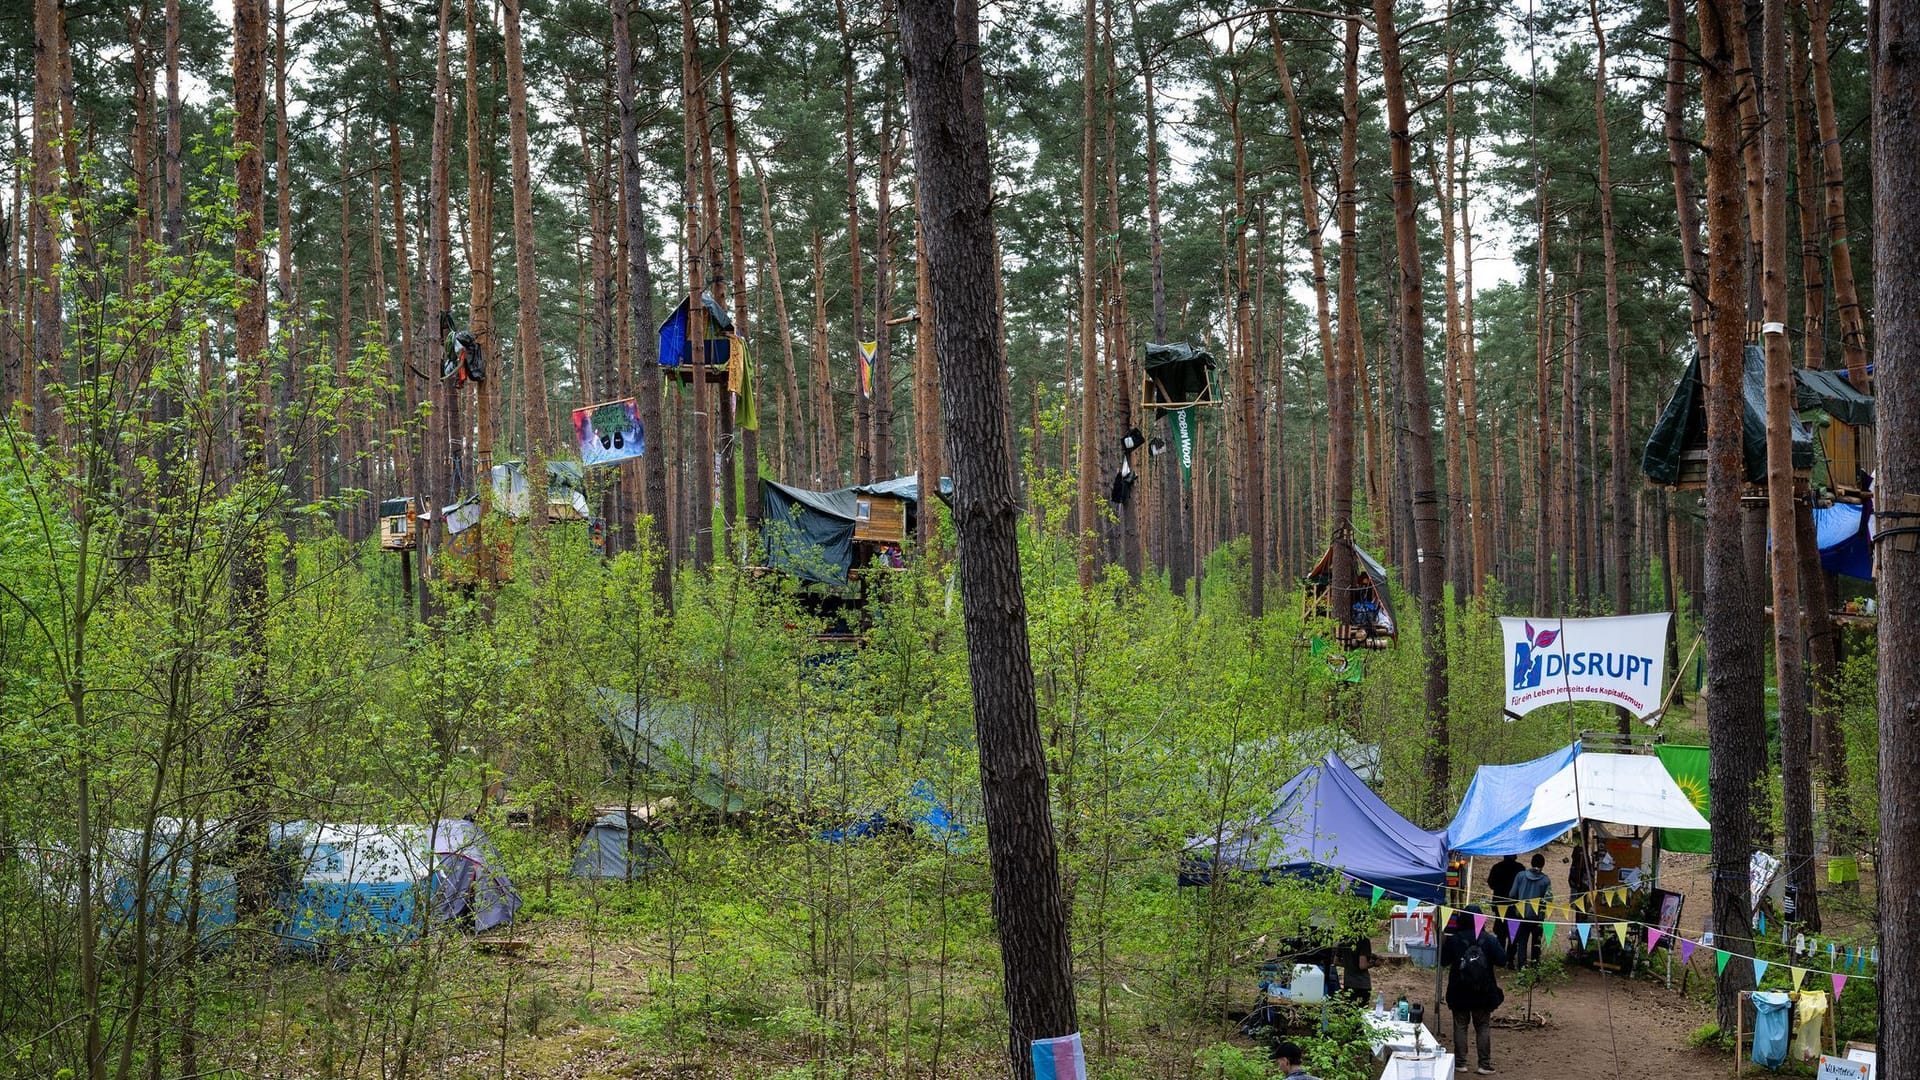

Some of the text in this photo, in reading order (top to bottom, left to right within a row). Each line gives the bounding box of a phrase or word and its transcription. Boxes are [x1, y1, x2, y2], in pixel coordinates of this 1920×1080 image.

[1177, 410, 1191, 468] ROBIN WOOD
[1546, 652, 1653, 686] DISRUPT
[1511, 685, 1644, 711] Für ein Leben jenseits des Kapitalismus!
